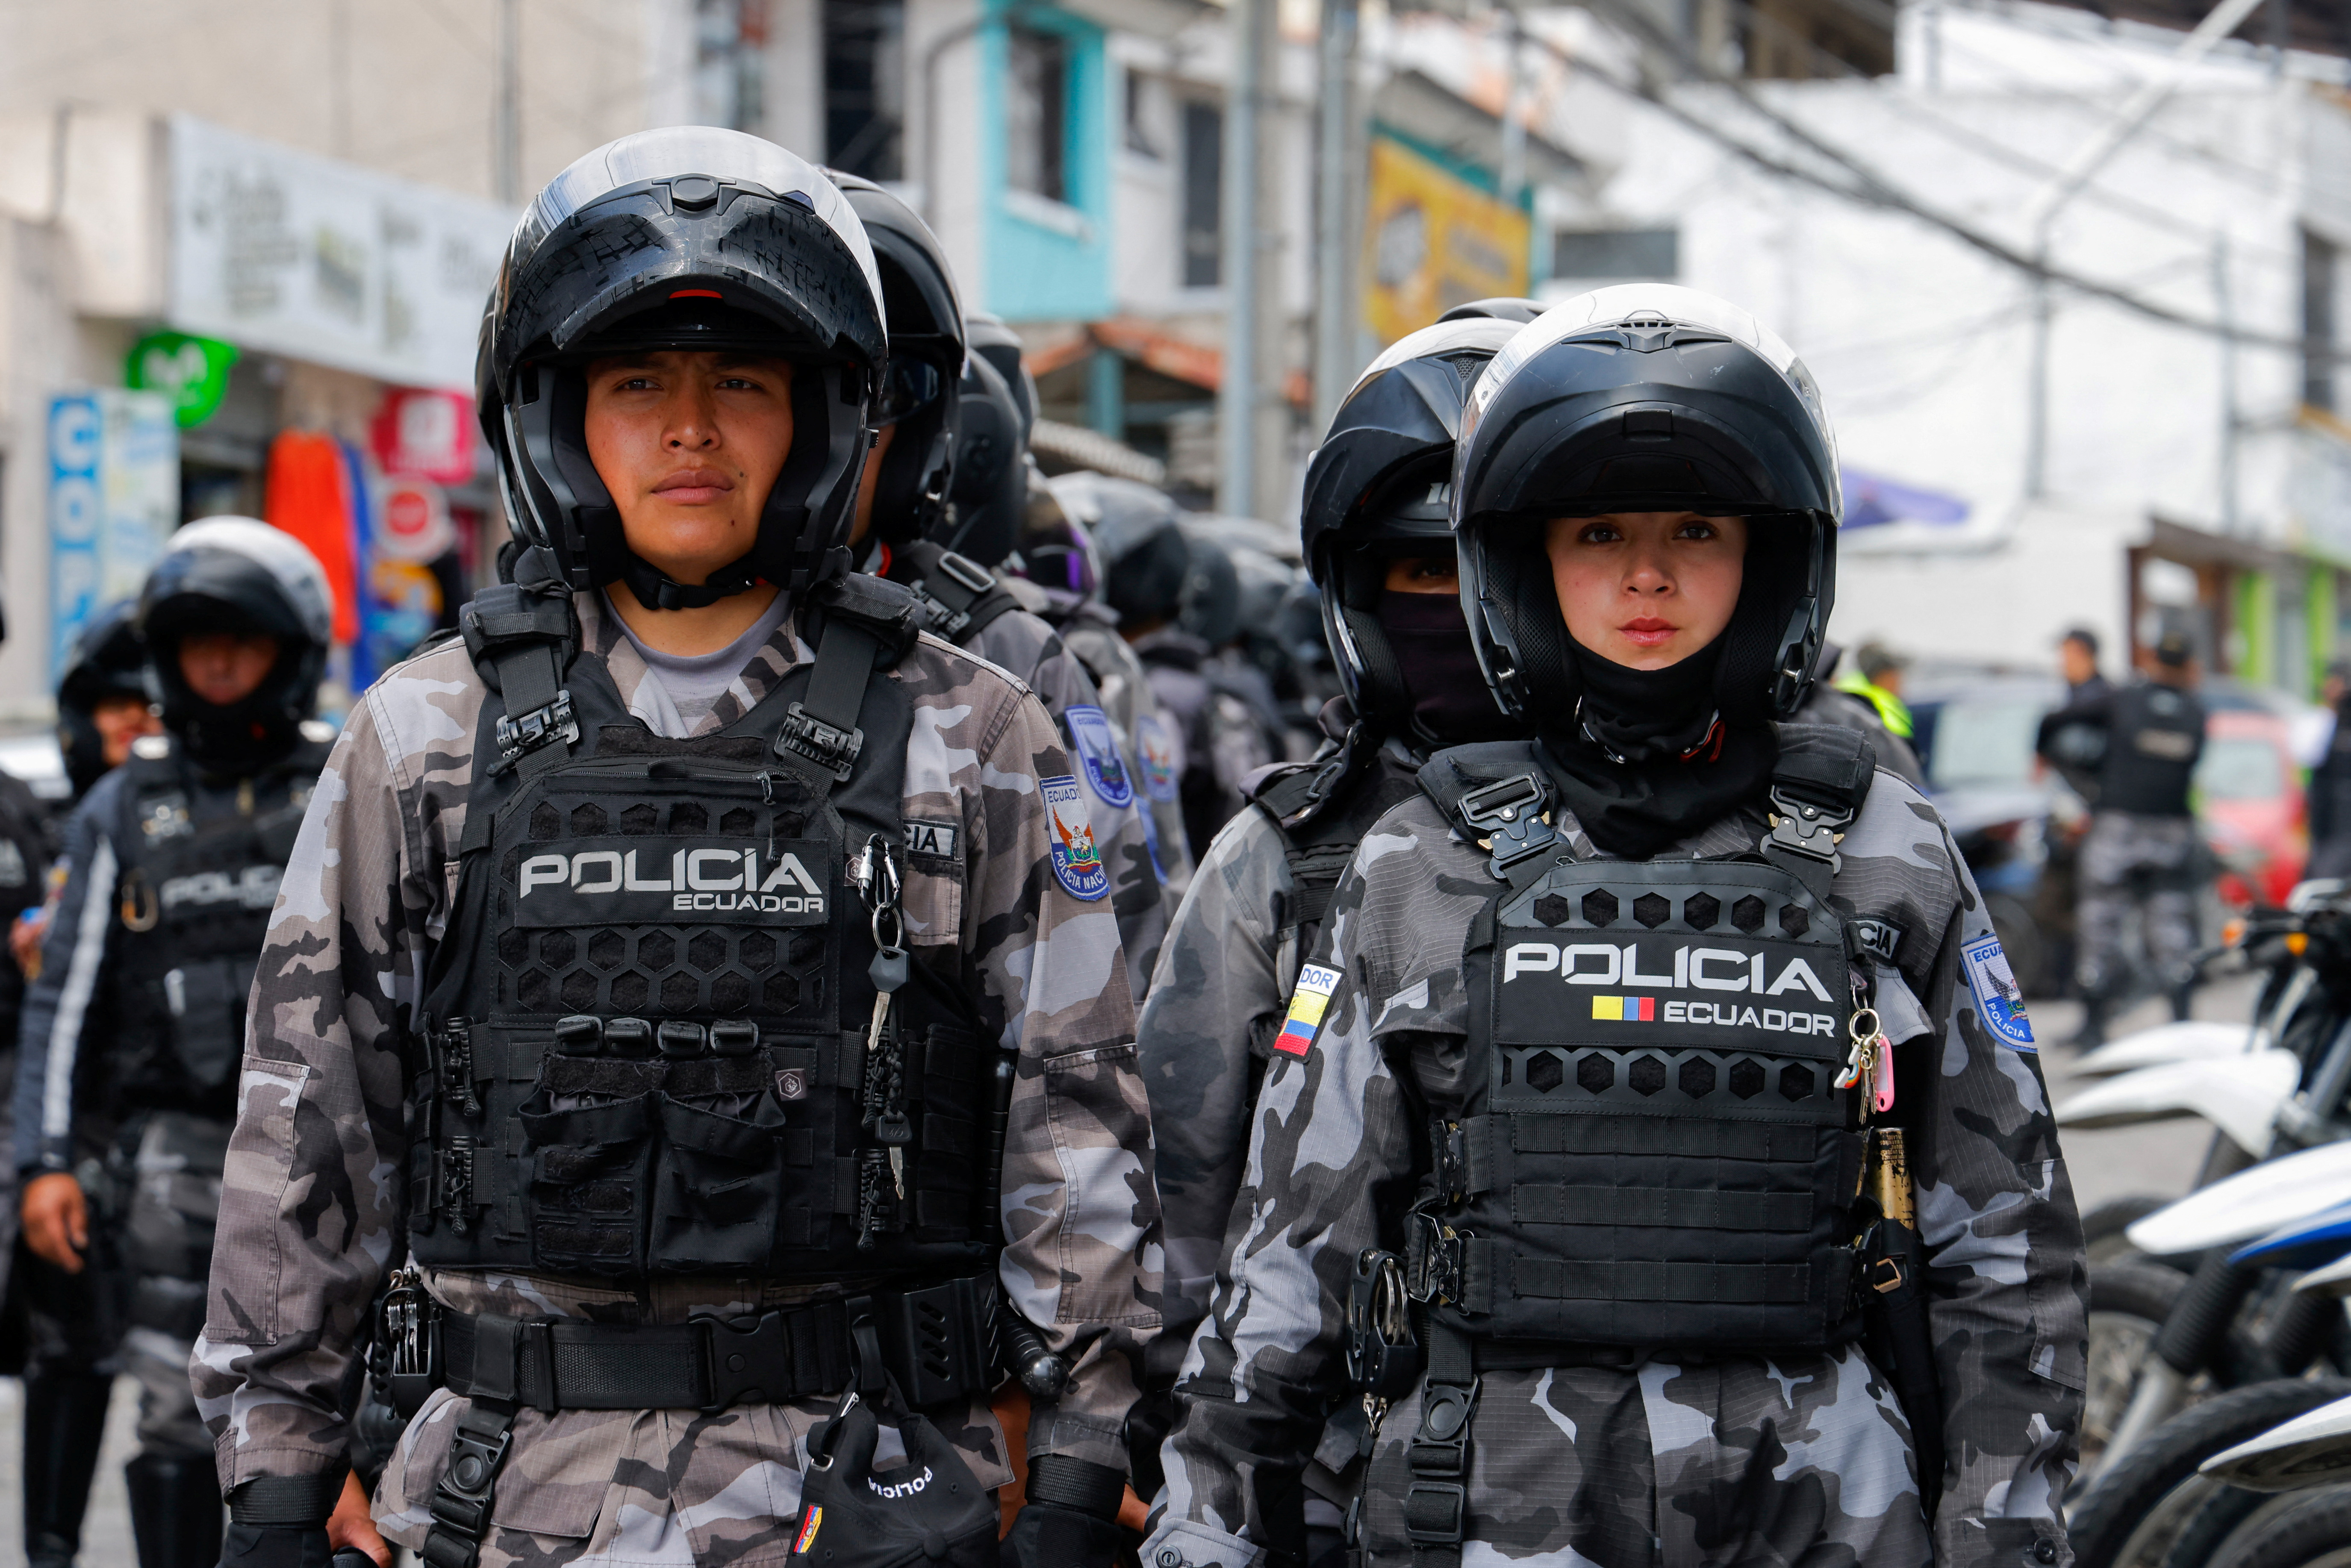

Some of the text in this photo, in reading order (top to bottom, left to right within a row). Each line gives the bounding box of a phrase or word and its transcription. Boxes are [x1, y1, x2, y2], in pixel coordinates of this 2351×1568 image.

[1055, 851, 1081, 889] POLICIA
[673, 893, 824, 913] ECUADOR
[1299, 968, 1334, 989] DOR
[1504, 943, 1834, 1002] POLICIA
[1664, 1001, 1835, 1037] ECUADOR
[1987, 1003, 2025, 1038] POLICIA
[868, 1466, 933, 1499] POLICIA
